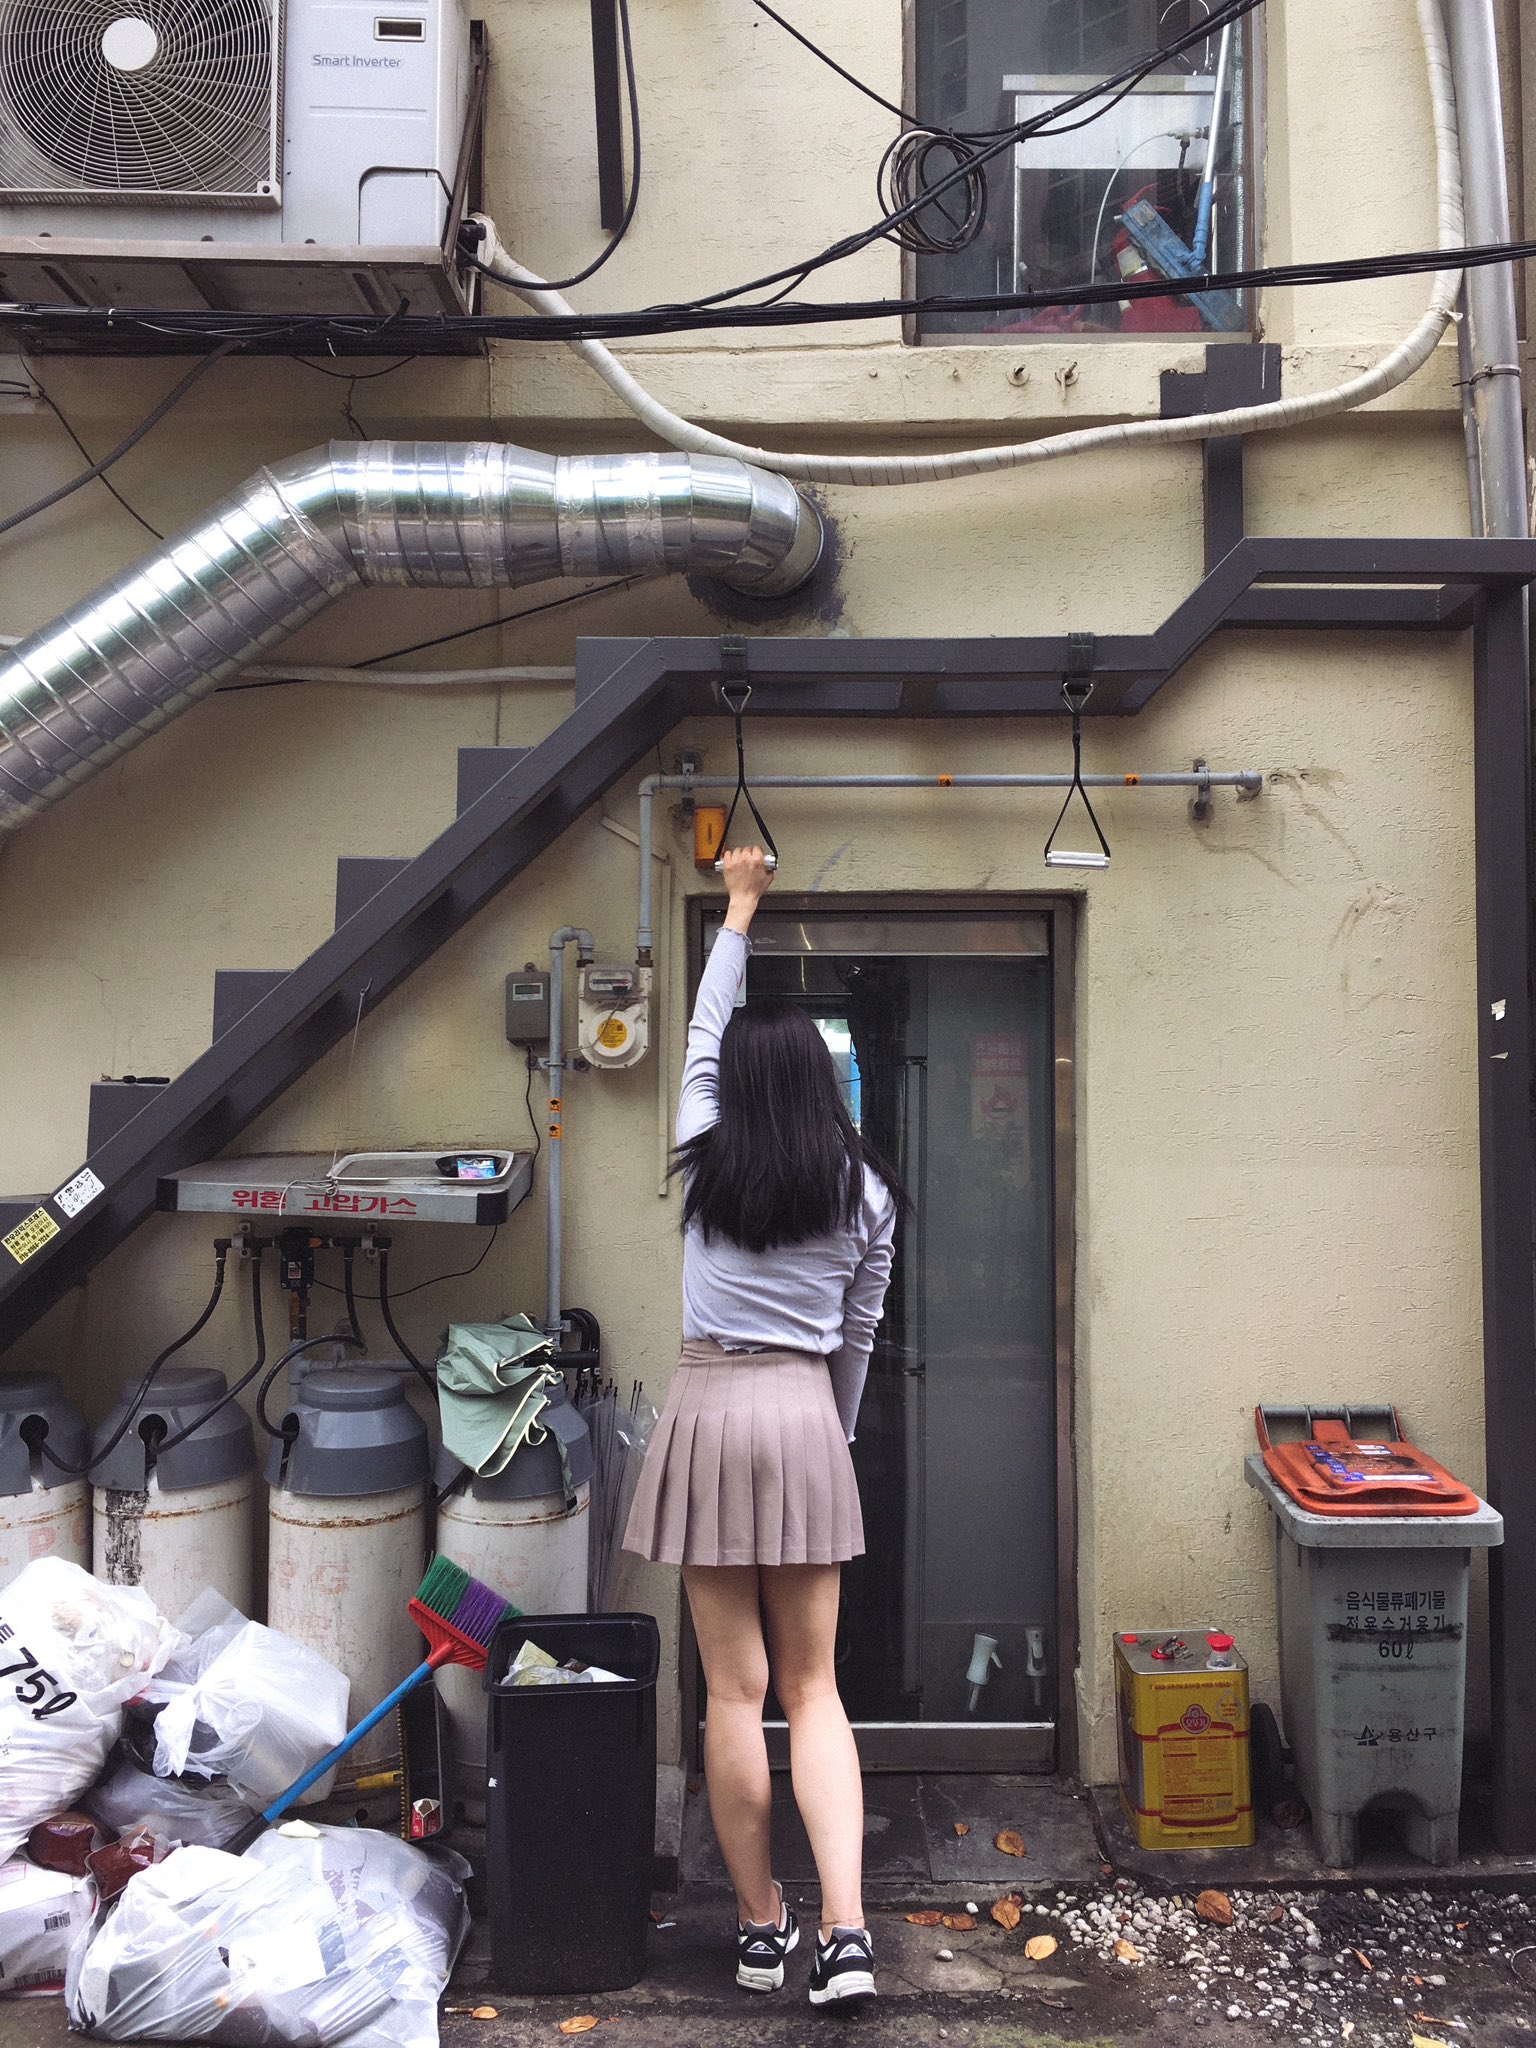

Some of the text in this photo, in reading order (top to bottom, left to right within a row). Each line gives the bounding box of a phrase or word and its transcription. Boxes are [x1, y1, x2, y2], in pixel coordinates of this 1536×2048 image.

[313, 54, 402, 67] Smart Inverter
[231, 1189, 417, 1215] 위험 고압가스
[1346, 1590, 1446, 1611] 음식물류폐기물
[1387, 1727, 1438, 1743] 용산구
